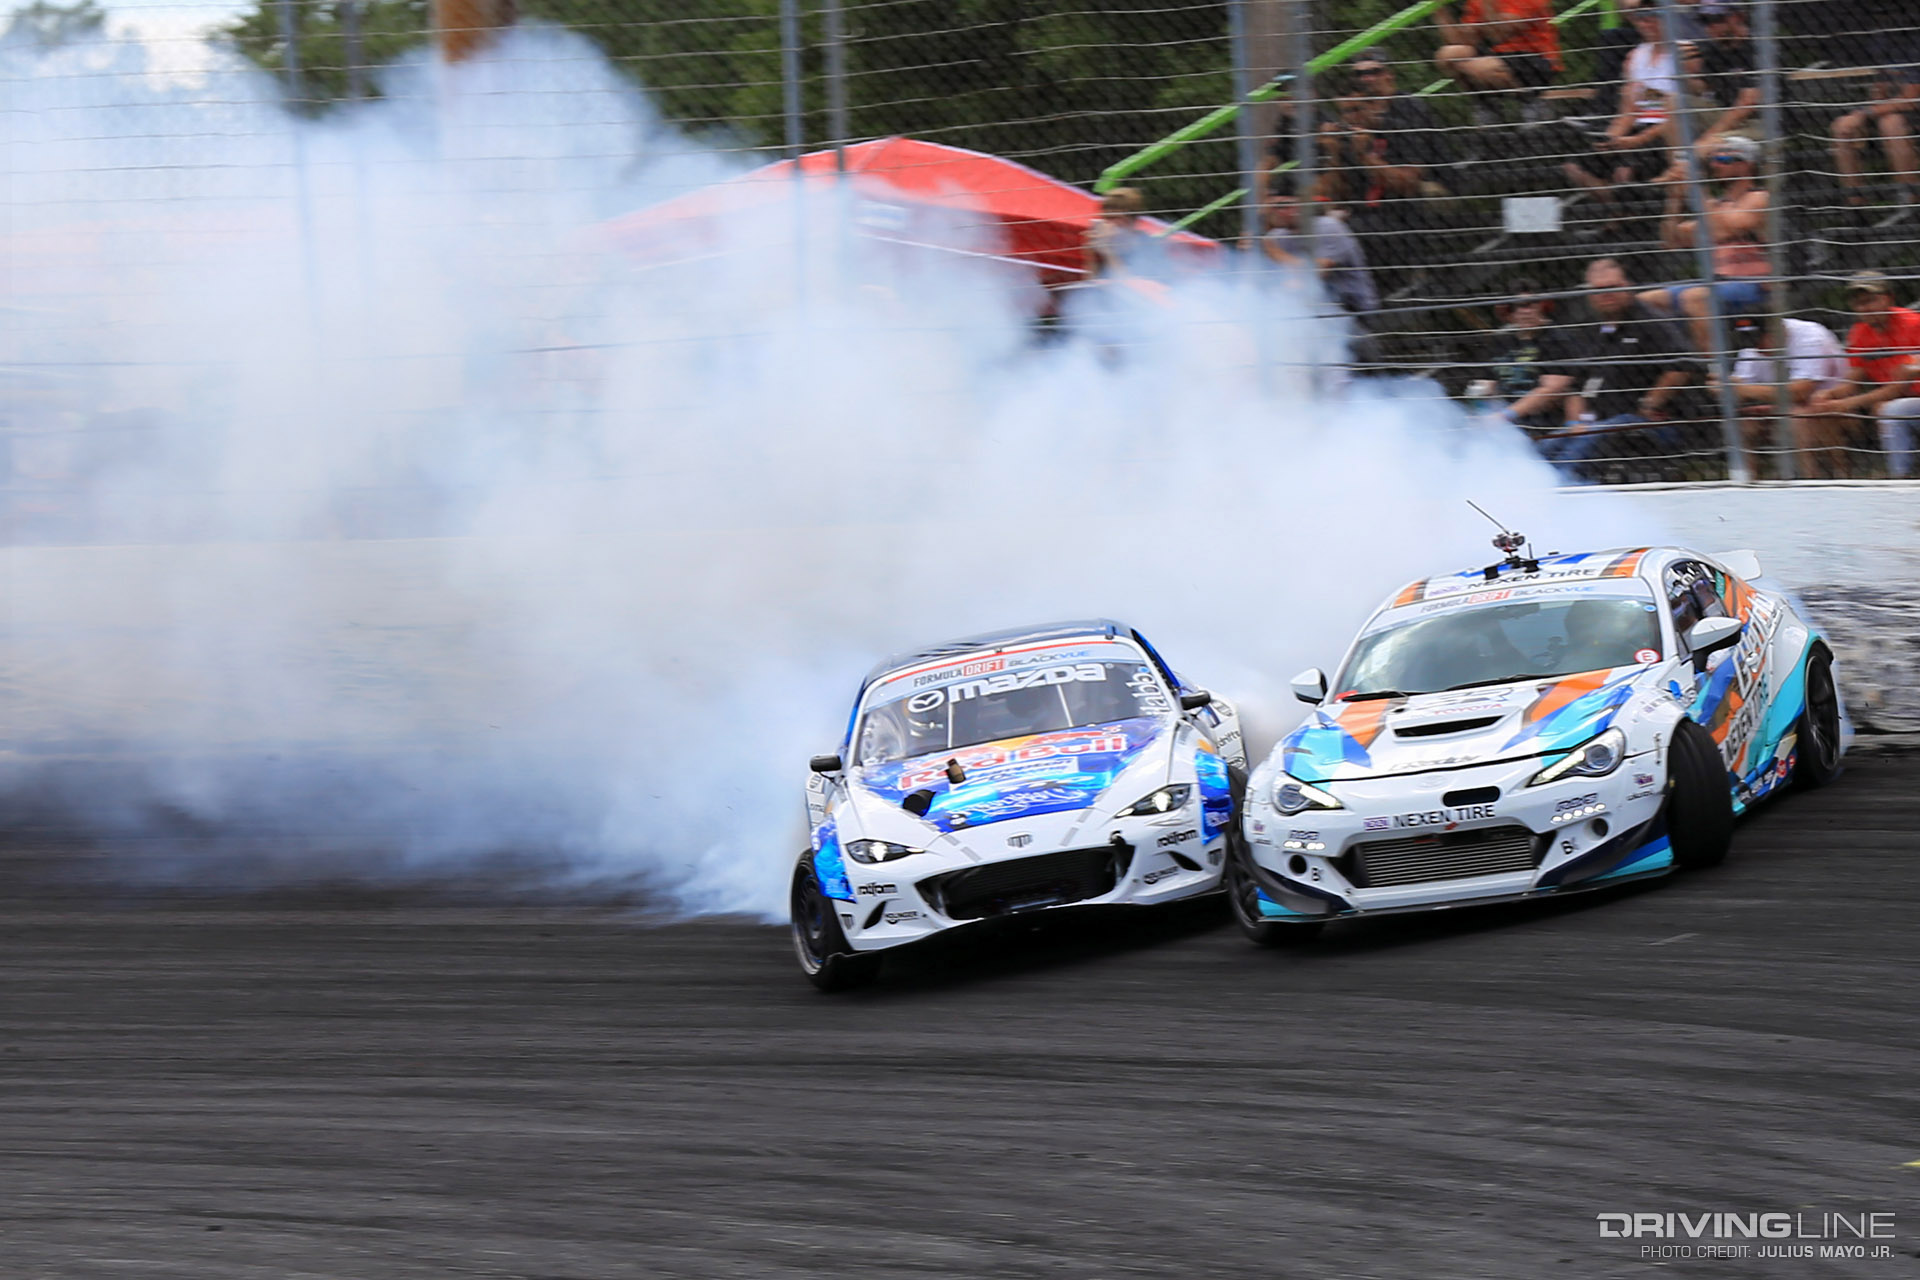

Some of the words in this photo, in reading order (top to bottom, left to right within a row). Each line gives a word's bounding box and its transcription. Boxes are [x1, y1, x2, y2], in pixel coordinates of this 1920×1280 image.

[1467, 573, 1540, 589] NEXEN
[1549, 568, 1596, 578] TIRE
[1641, 651, 1653, 662] E
[913, 669, 962, 687] FORMULA
[965, 660, 1003, 677] DRIFT
[1008, 650, 1091, 667] BLACKVUE
[1434, 704, 1502, 715] TOYOTA
[1018, 736, 1128, 761] Bull
[1393, 810, 1450, 828] NEXEN
[1455, 805, 1496, 820] TIRE
